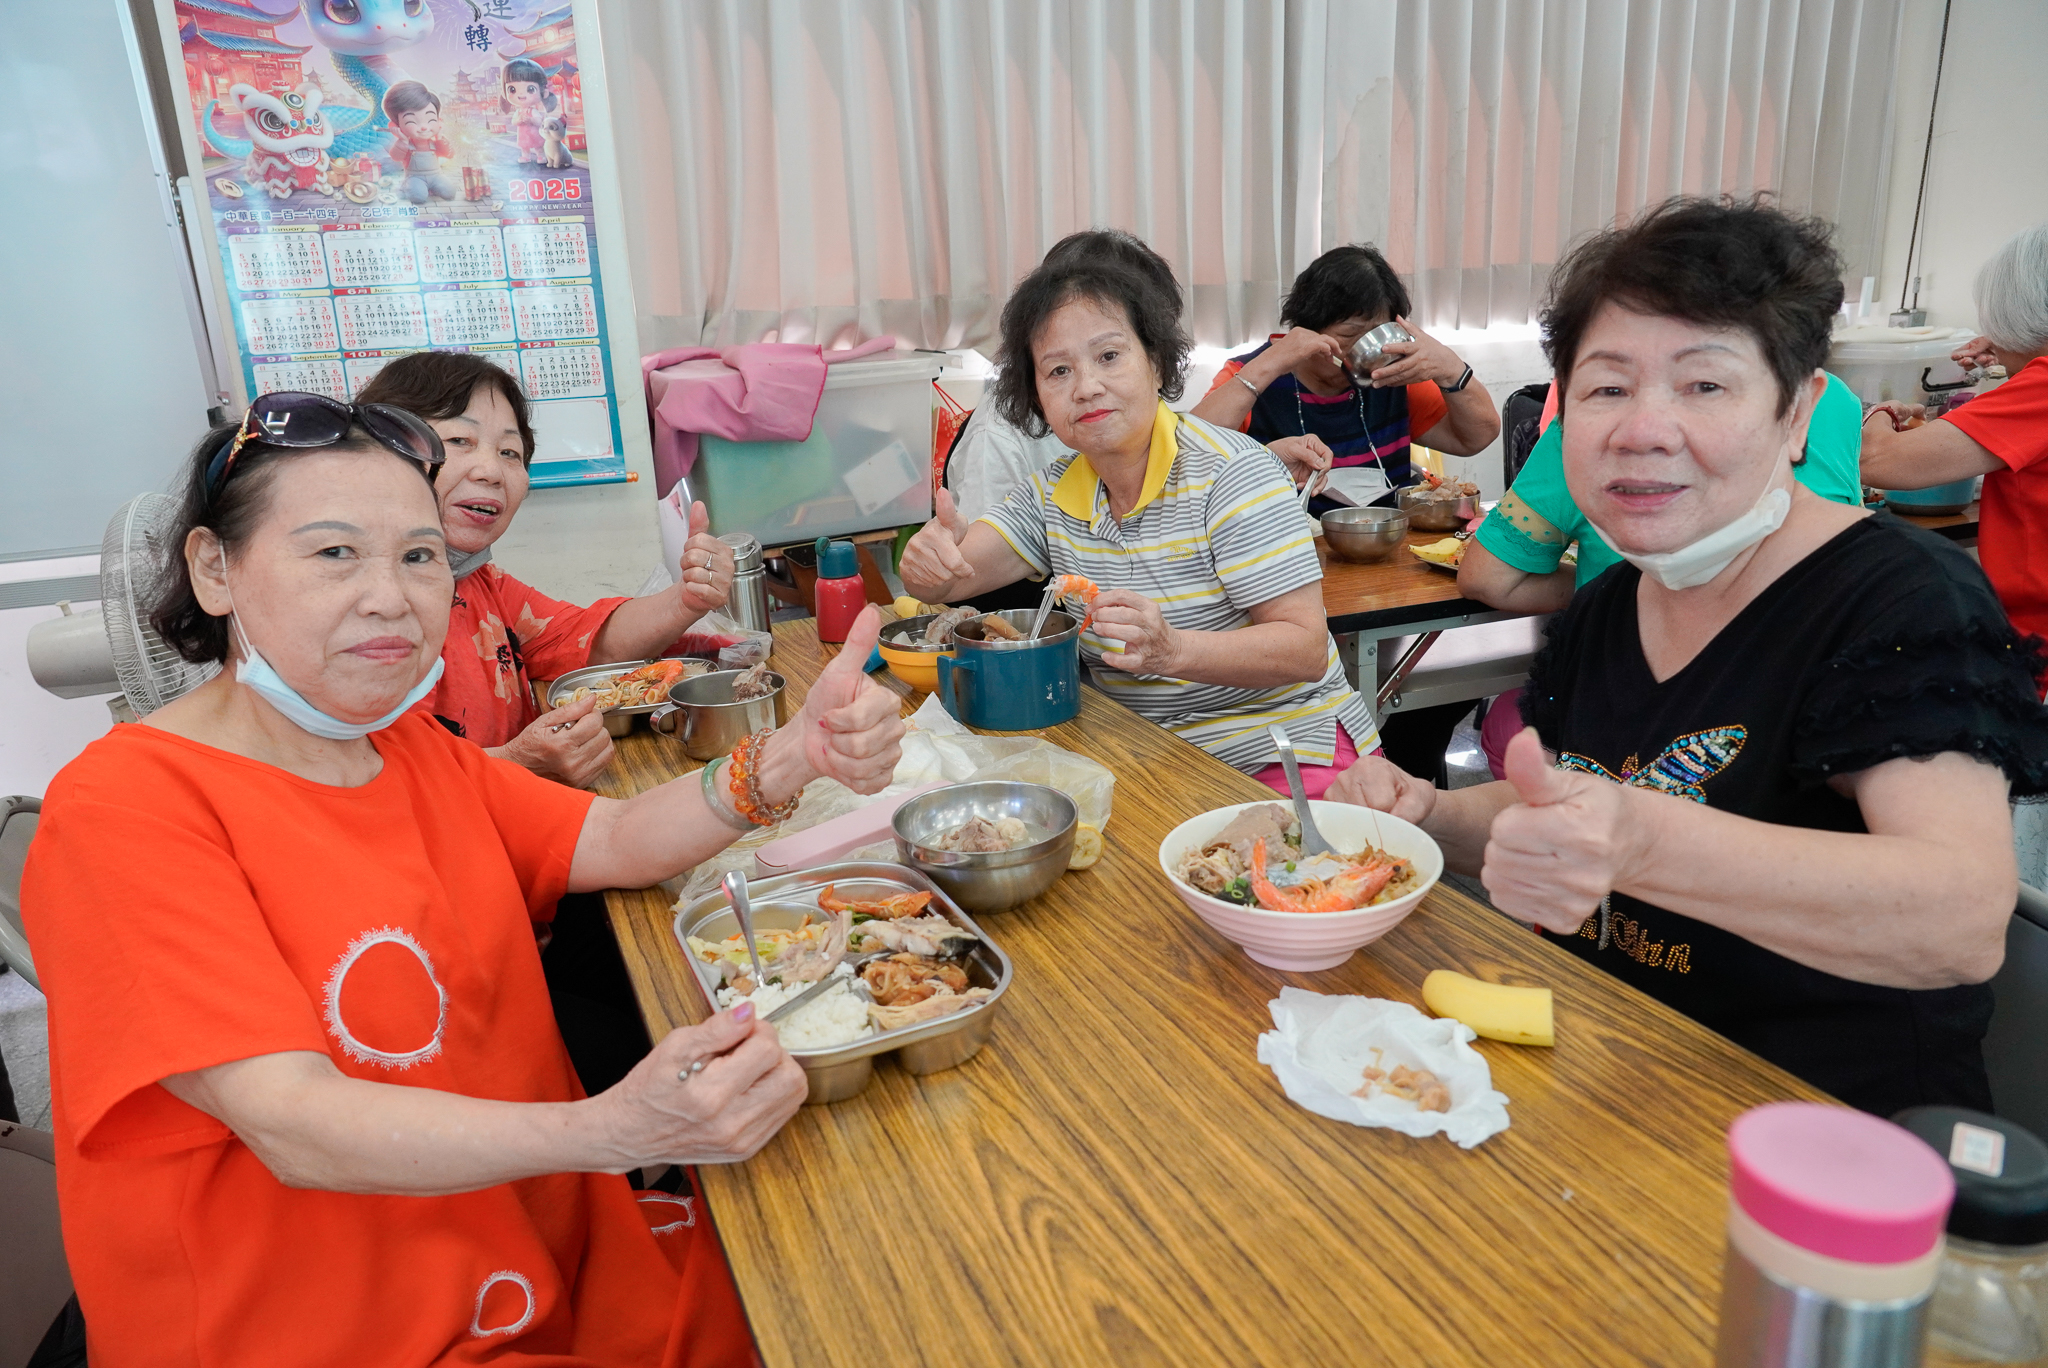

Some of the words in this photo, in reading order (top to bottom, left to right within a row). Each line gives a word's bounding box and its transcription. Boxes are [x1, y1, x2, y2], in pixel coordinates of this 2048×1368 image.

[509, 178, 582, 201] 2025
[225, 208, 338, 221] 中華民國一百一十四年
